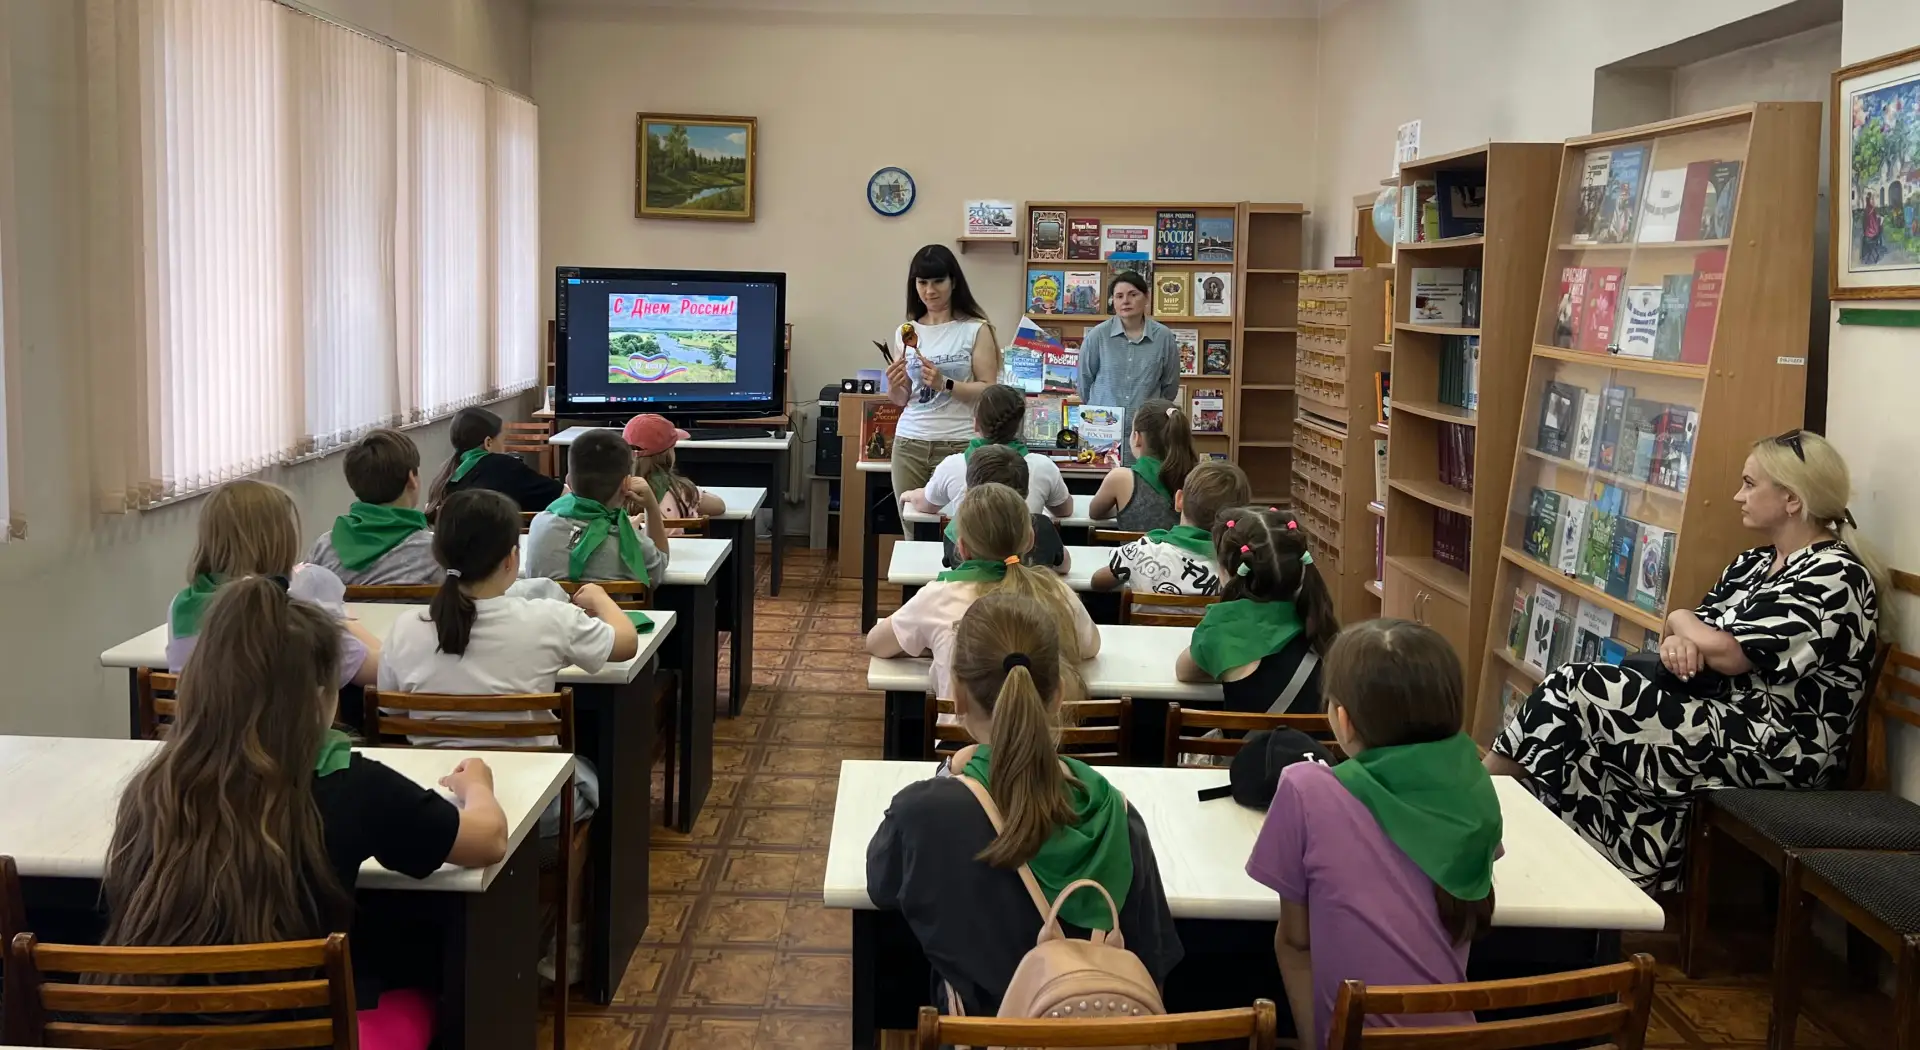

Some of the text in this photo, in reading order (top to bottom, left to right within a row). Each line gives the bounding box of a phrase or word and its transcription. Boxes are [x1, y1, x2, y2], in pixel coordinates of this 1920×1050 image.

[1158, 230, 1194, 244] РОССИЯ
[613, 297, 735, 318] С Днем России!
